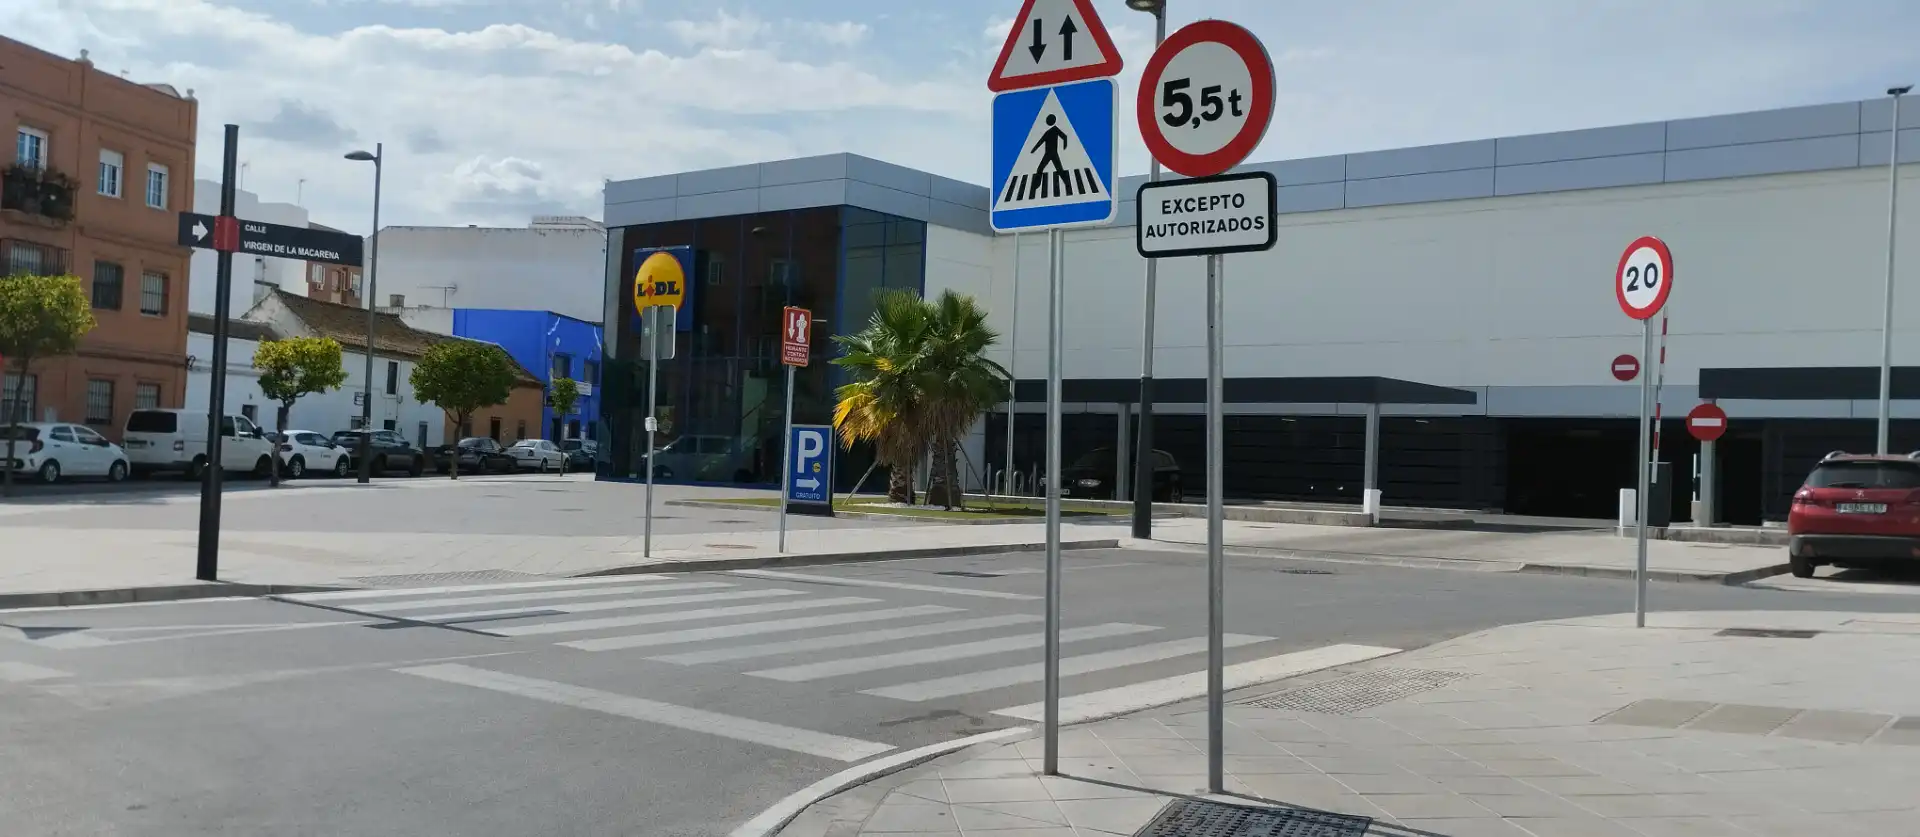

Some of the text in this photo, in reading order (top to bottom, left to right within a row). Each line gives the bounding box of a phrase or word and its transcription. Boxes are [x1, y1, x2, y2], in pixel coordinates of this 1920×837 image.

[1162, 193, 1244, 215] EXCEPTO
[244, 224, 266, 234] CALLE
[1145, 216, 1264, 238] AUTORIZADOS
[244, 240, 340, 260] VIRGEN DE LA MACARENA
[1626, 262, 1658, 292] 20
[798, 430, 824, 473] P
